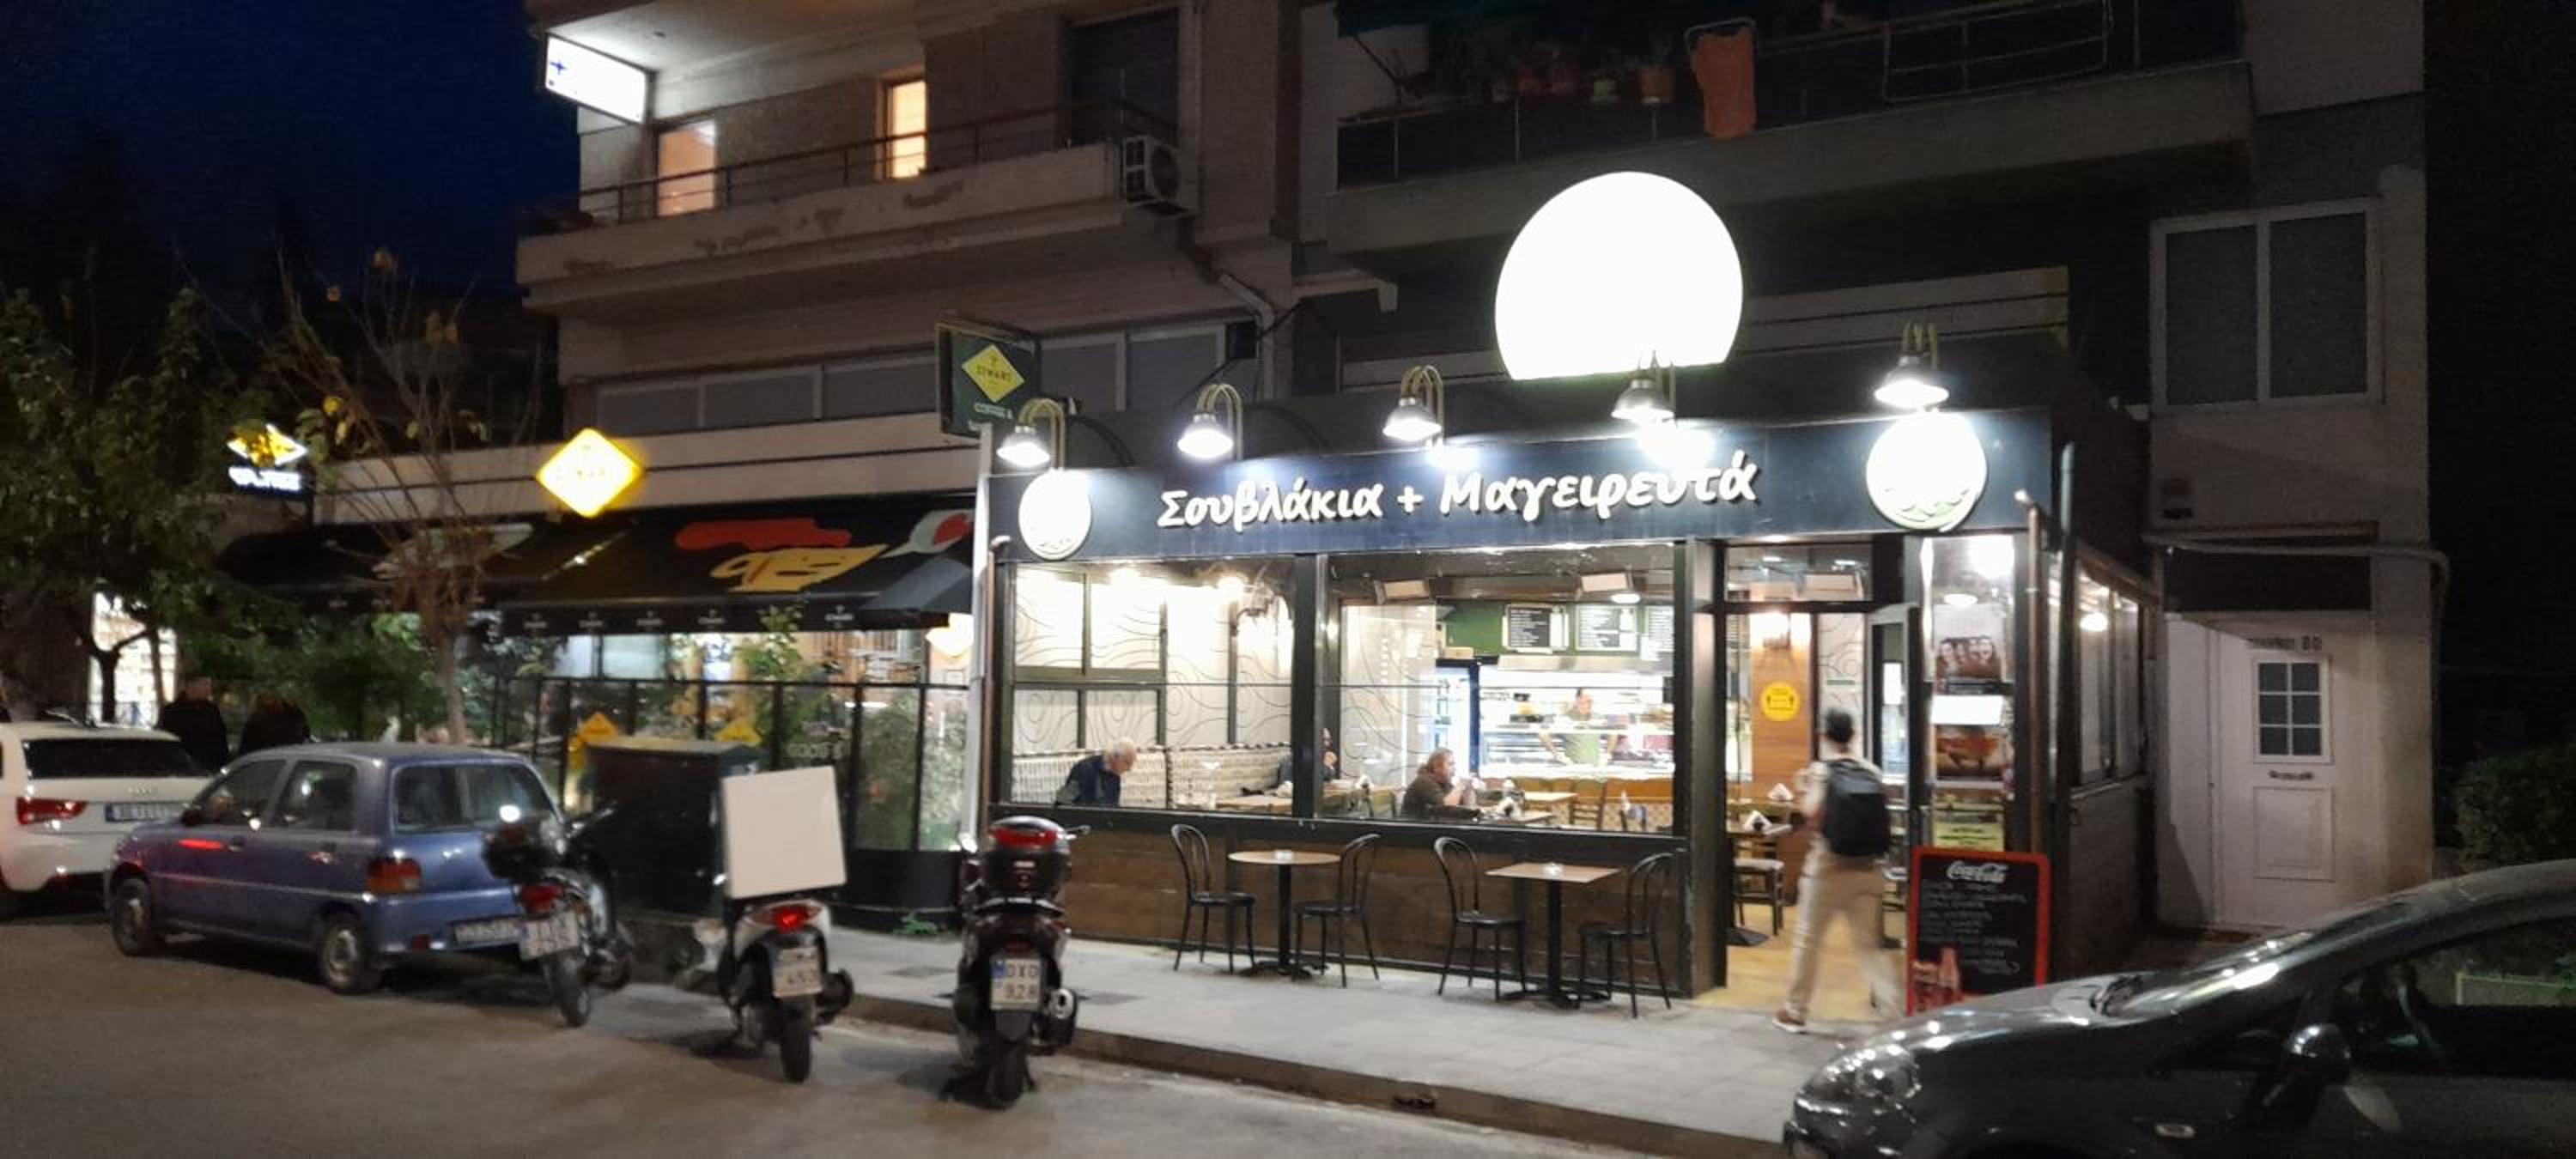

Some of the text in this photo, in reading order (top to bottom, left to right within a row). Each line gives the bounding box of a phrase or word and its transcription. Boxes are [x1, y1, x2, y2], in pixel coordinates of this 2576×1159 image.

[1157, 449, 1758, 532] Σουβλάκια + Μαγειρευτά
